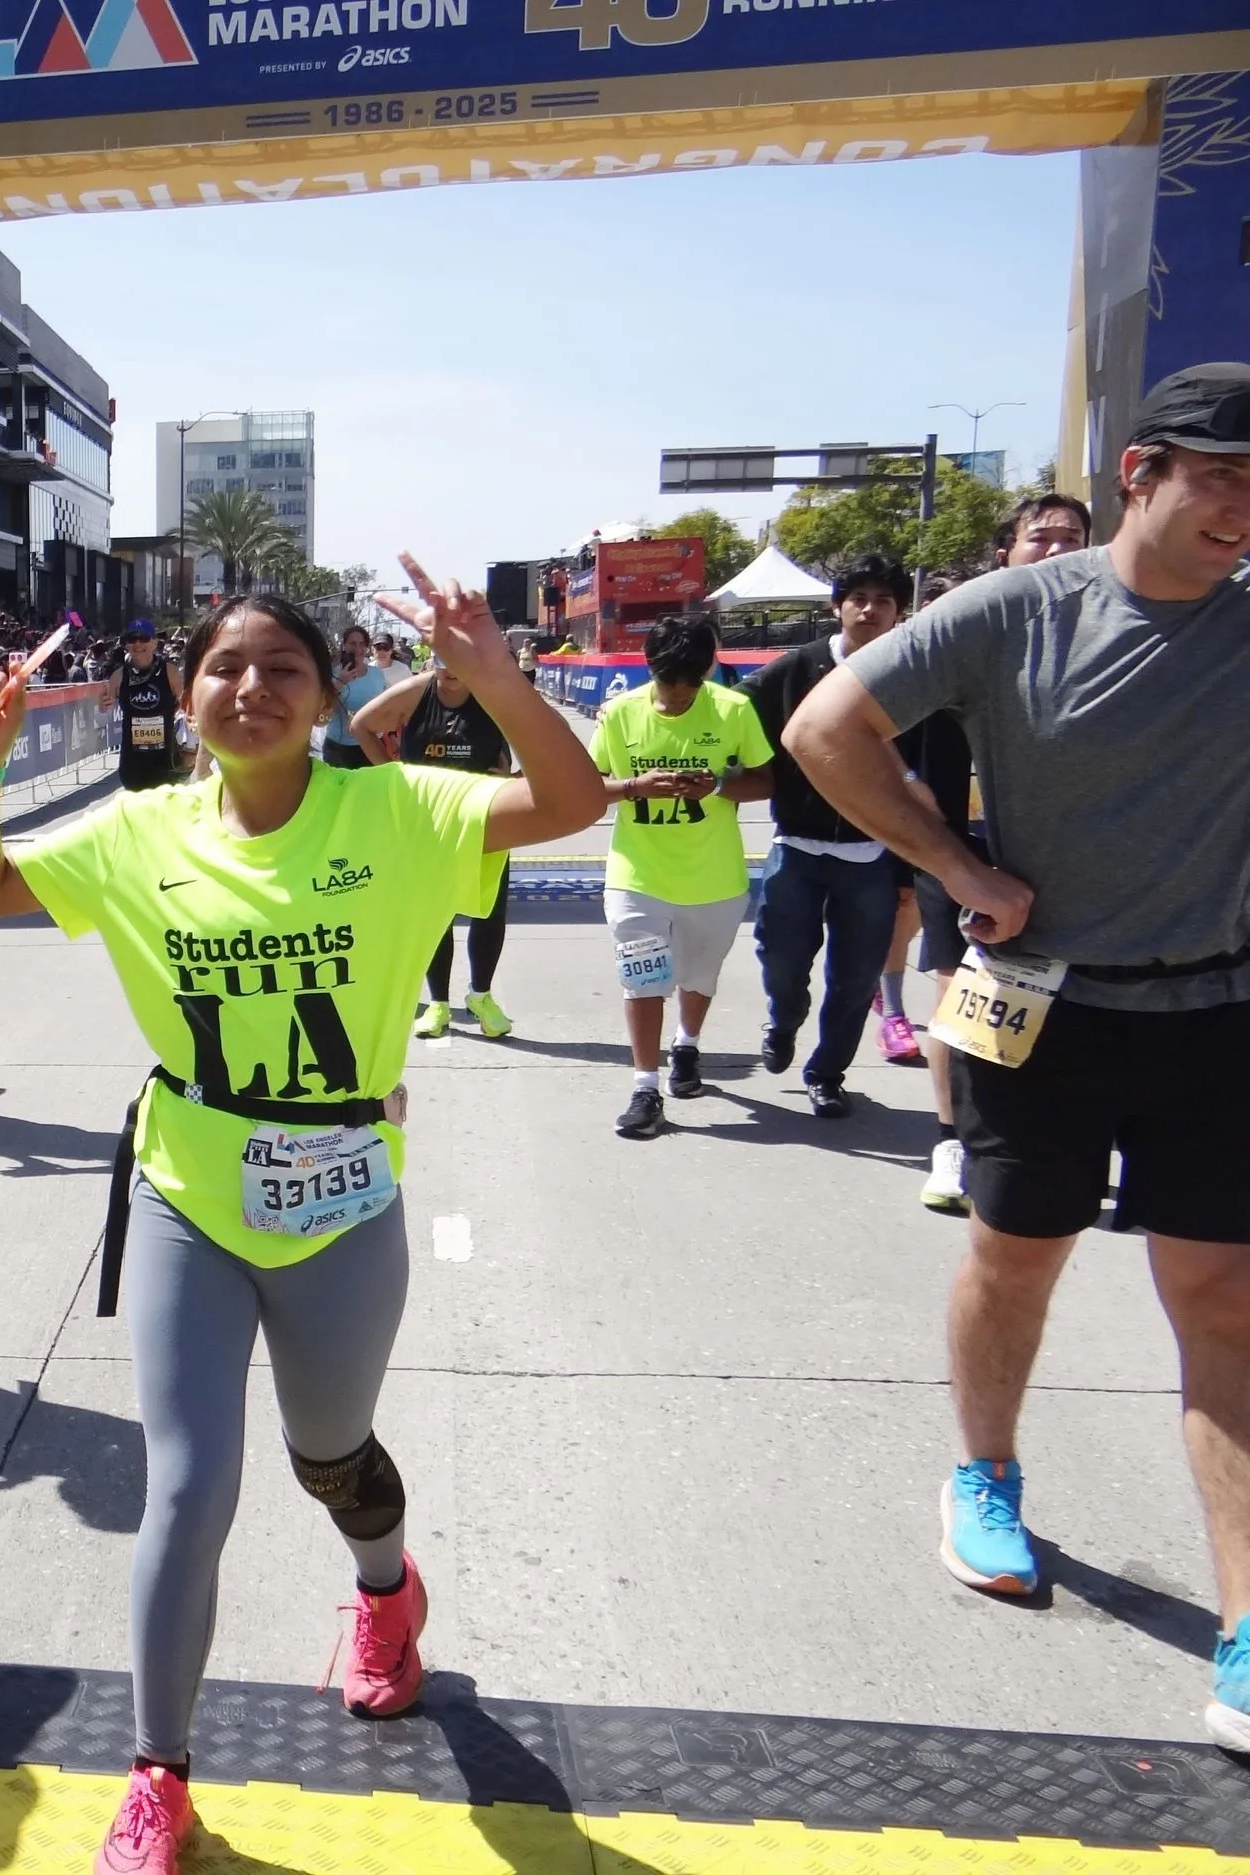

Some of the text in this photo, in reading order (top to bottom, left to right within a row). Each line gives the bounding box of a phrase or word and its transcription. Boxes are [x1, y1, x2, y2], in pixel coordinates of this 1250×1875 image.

[208, 0, 468, 46] MARATHON
[259, 47, 411, 74] PRESENTED BY asics
[323, 100, 405, 127] 1986
[434, 91, 518, 119] 2025
[425, 744, 446, 758] 40
[630, 755, 709, 769] Students
[632, 796, 709, 825] LA
[311, 864, 374, 893] LA84
[321, 882, 369, 897] FOUNDATION
[164, 922, 355, 963] Students
[170, 955, 357, 997] run
[622, 954, 668, 978] 30841
[173, 991, 360, 1099] LA
[305, 1138, 344, 1150] MARATHON
[261, 1156, 371, 1211] 33139
[314, 1208, 346, 1226] asics
